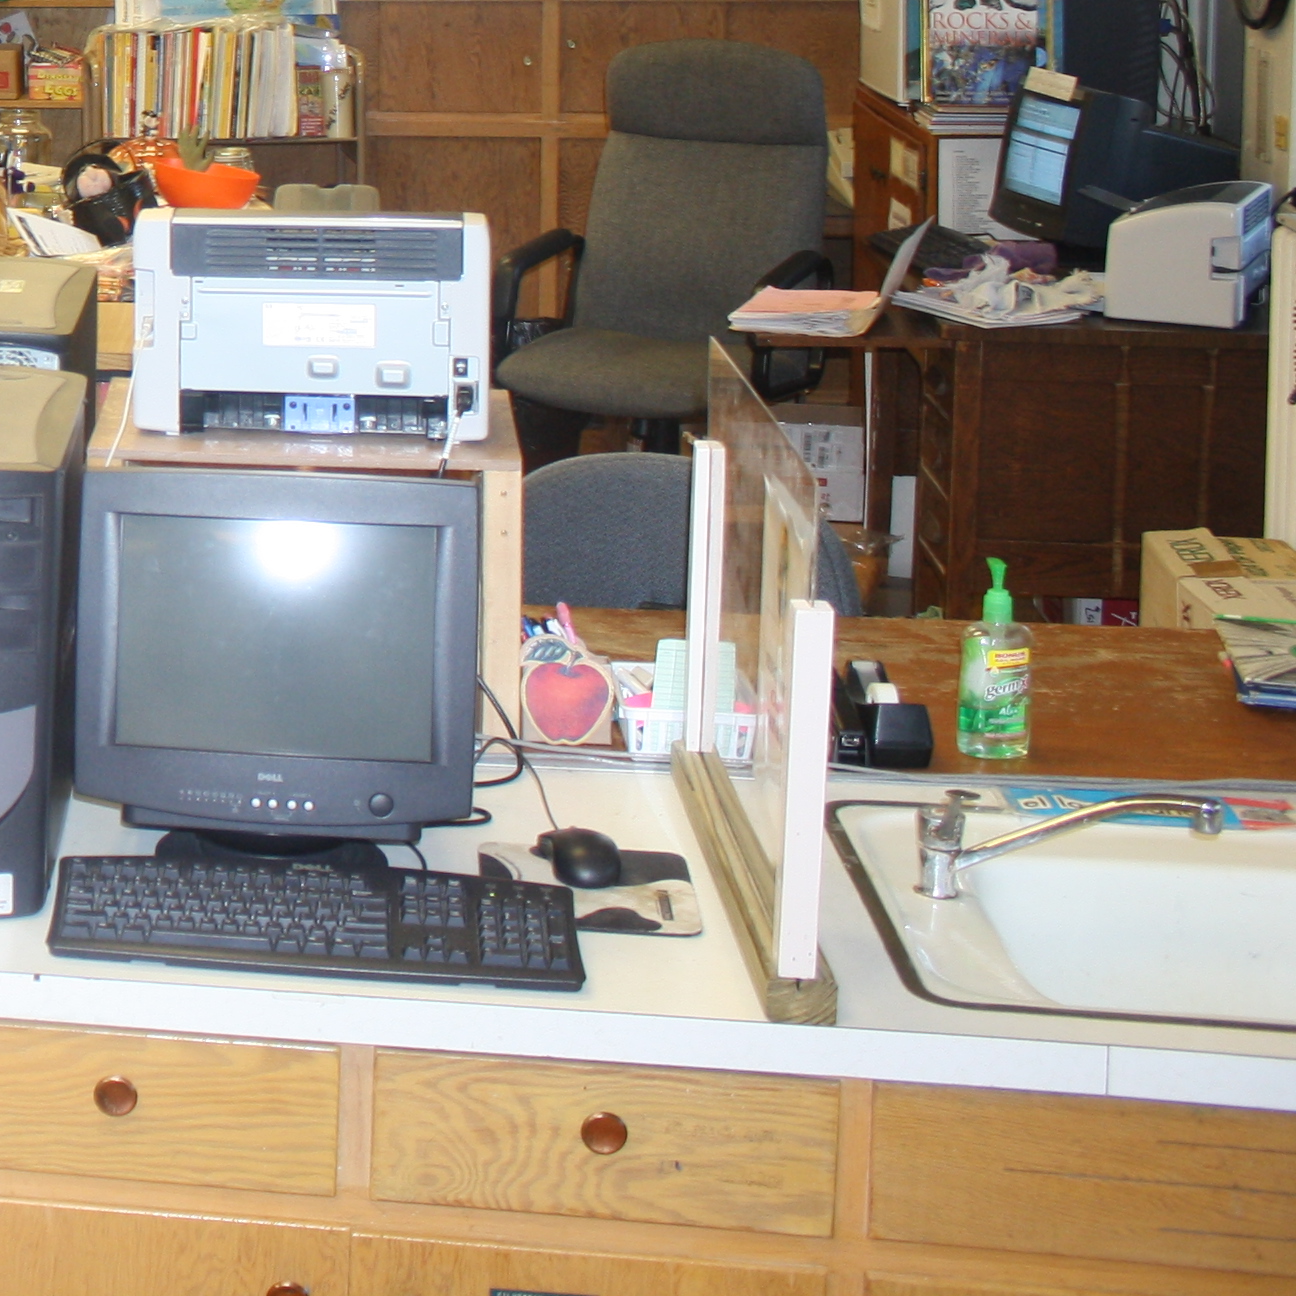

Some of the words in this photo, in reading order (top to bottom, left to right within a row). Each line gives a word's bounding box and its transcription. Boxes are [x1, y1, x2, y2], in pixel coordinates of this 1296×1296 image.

[933, 12, 1009, 30] ROCKS
[1014, 12, 1034, 30] &
[933, 30, 1038, 46] MINERALS
[258, 772, 284, 783] DELL
[1020, 795, 1048, 810] el
[292, 862, 334, 873] DELL
